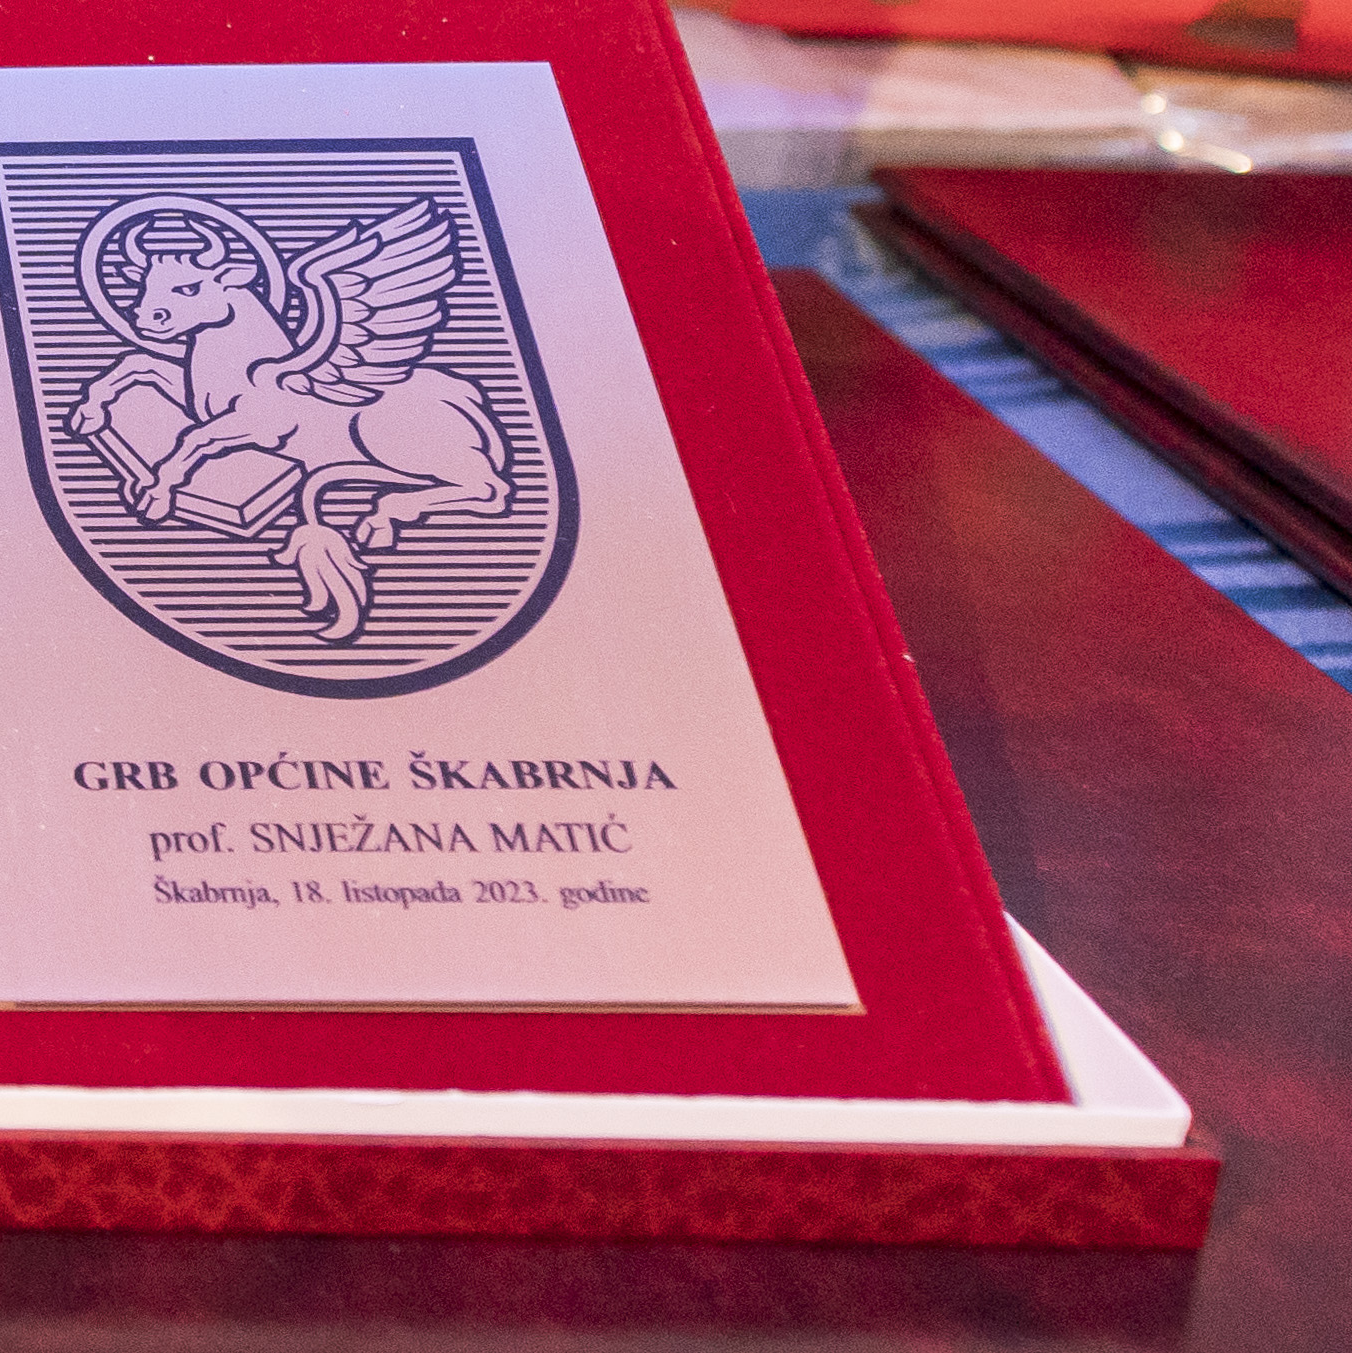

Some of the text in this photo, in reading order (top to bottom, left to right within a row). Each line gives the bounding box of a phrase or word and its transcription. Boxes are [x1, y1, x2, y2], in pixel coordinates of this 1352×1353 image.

[73, 751, 679, 791] GRB OPĆINE ŠKABRNJA
[149, 813, 633, 861] prof. SNJEŽANA MATIĆ
[153, 875, 651, 910] Škabrnja, 18. listopada 2023. godine
